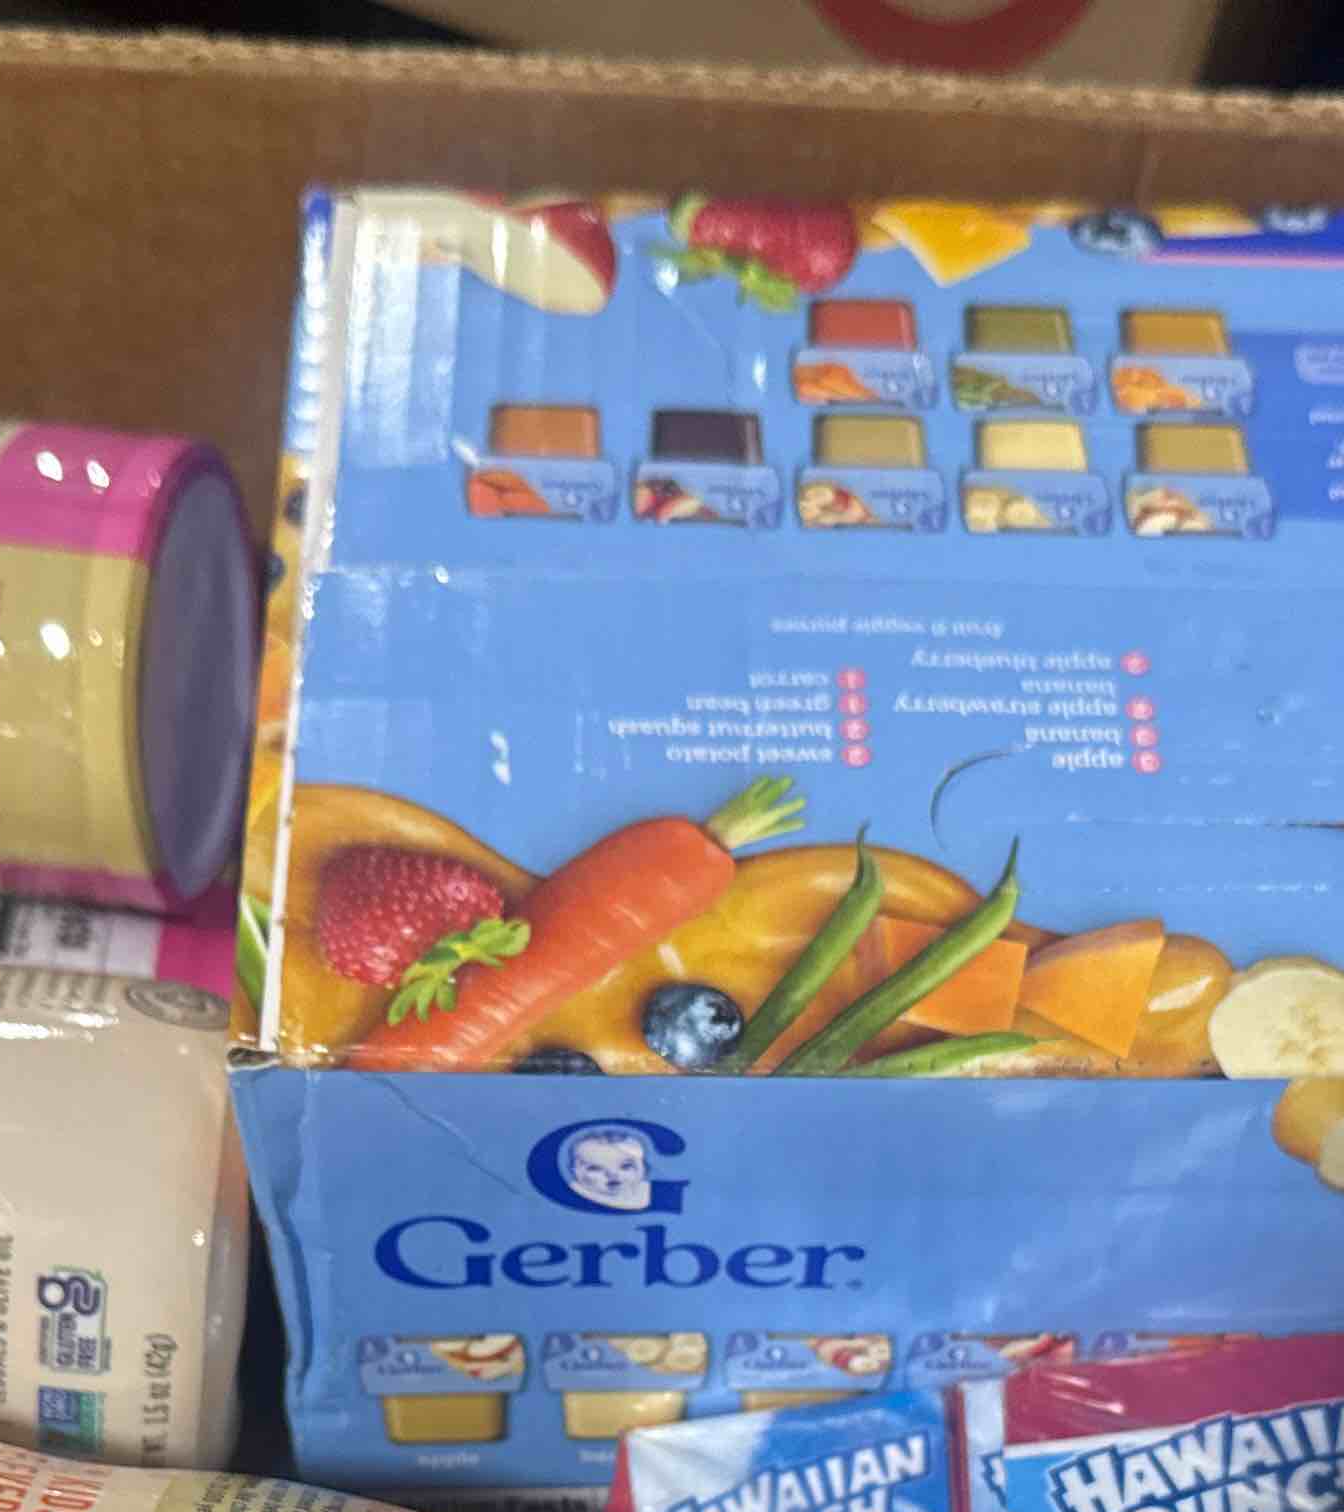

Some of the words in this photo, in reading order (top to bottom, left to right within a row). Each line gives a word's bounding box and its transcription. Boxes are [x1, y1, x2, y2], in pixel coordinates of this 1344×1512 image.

[909, 648, 1036, 669] blueberry
[1040, 652, 1111, 671] apple
[892, 692, 1041, 715] strawberry
[1047, 697, 1117, 718] apple
[1024, 726, 1123, 745] banana
[666, 745, 750, 764] potato
[757, 747, 831, 764] sweet
[1052, 751, 1125, 770] apple
[374, 1216, 866, 1290] Gerber
